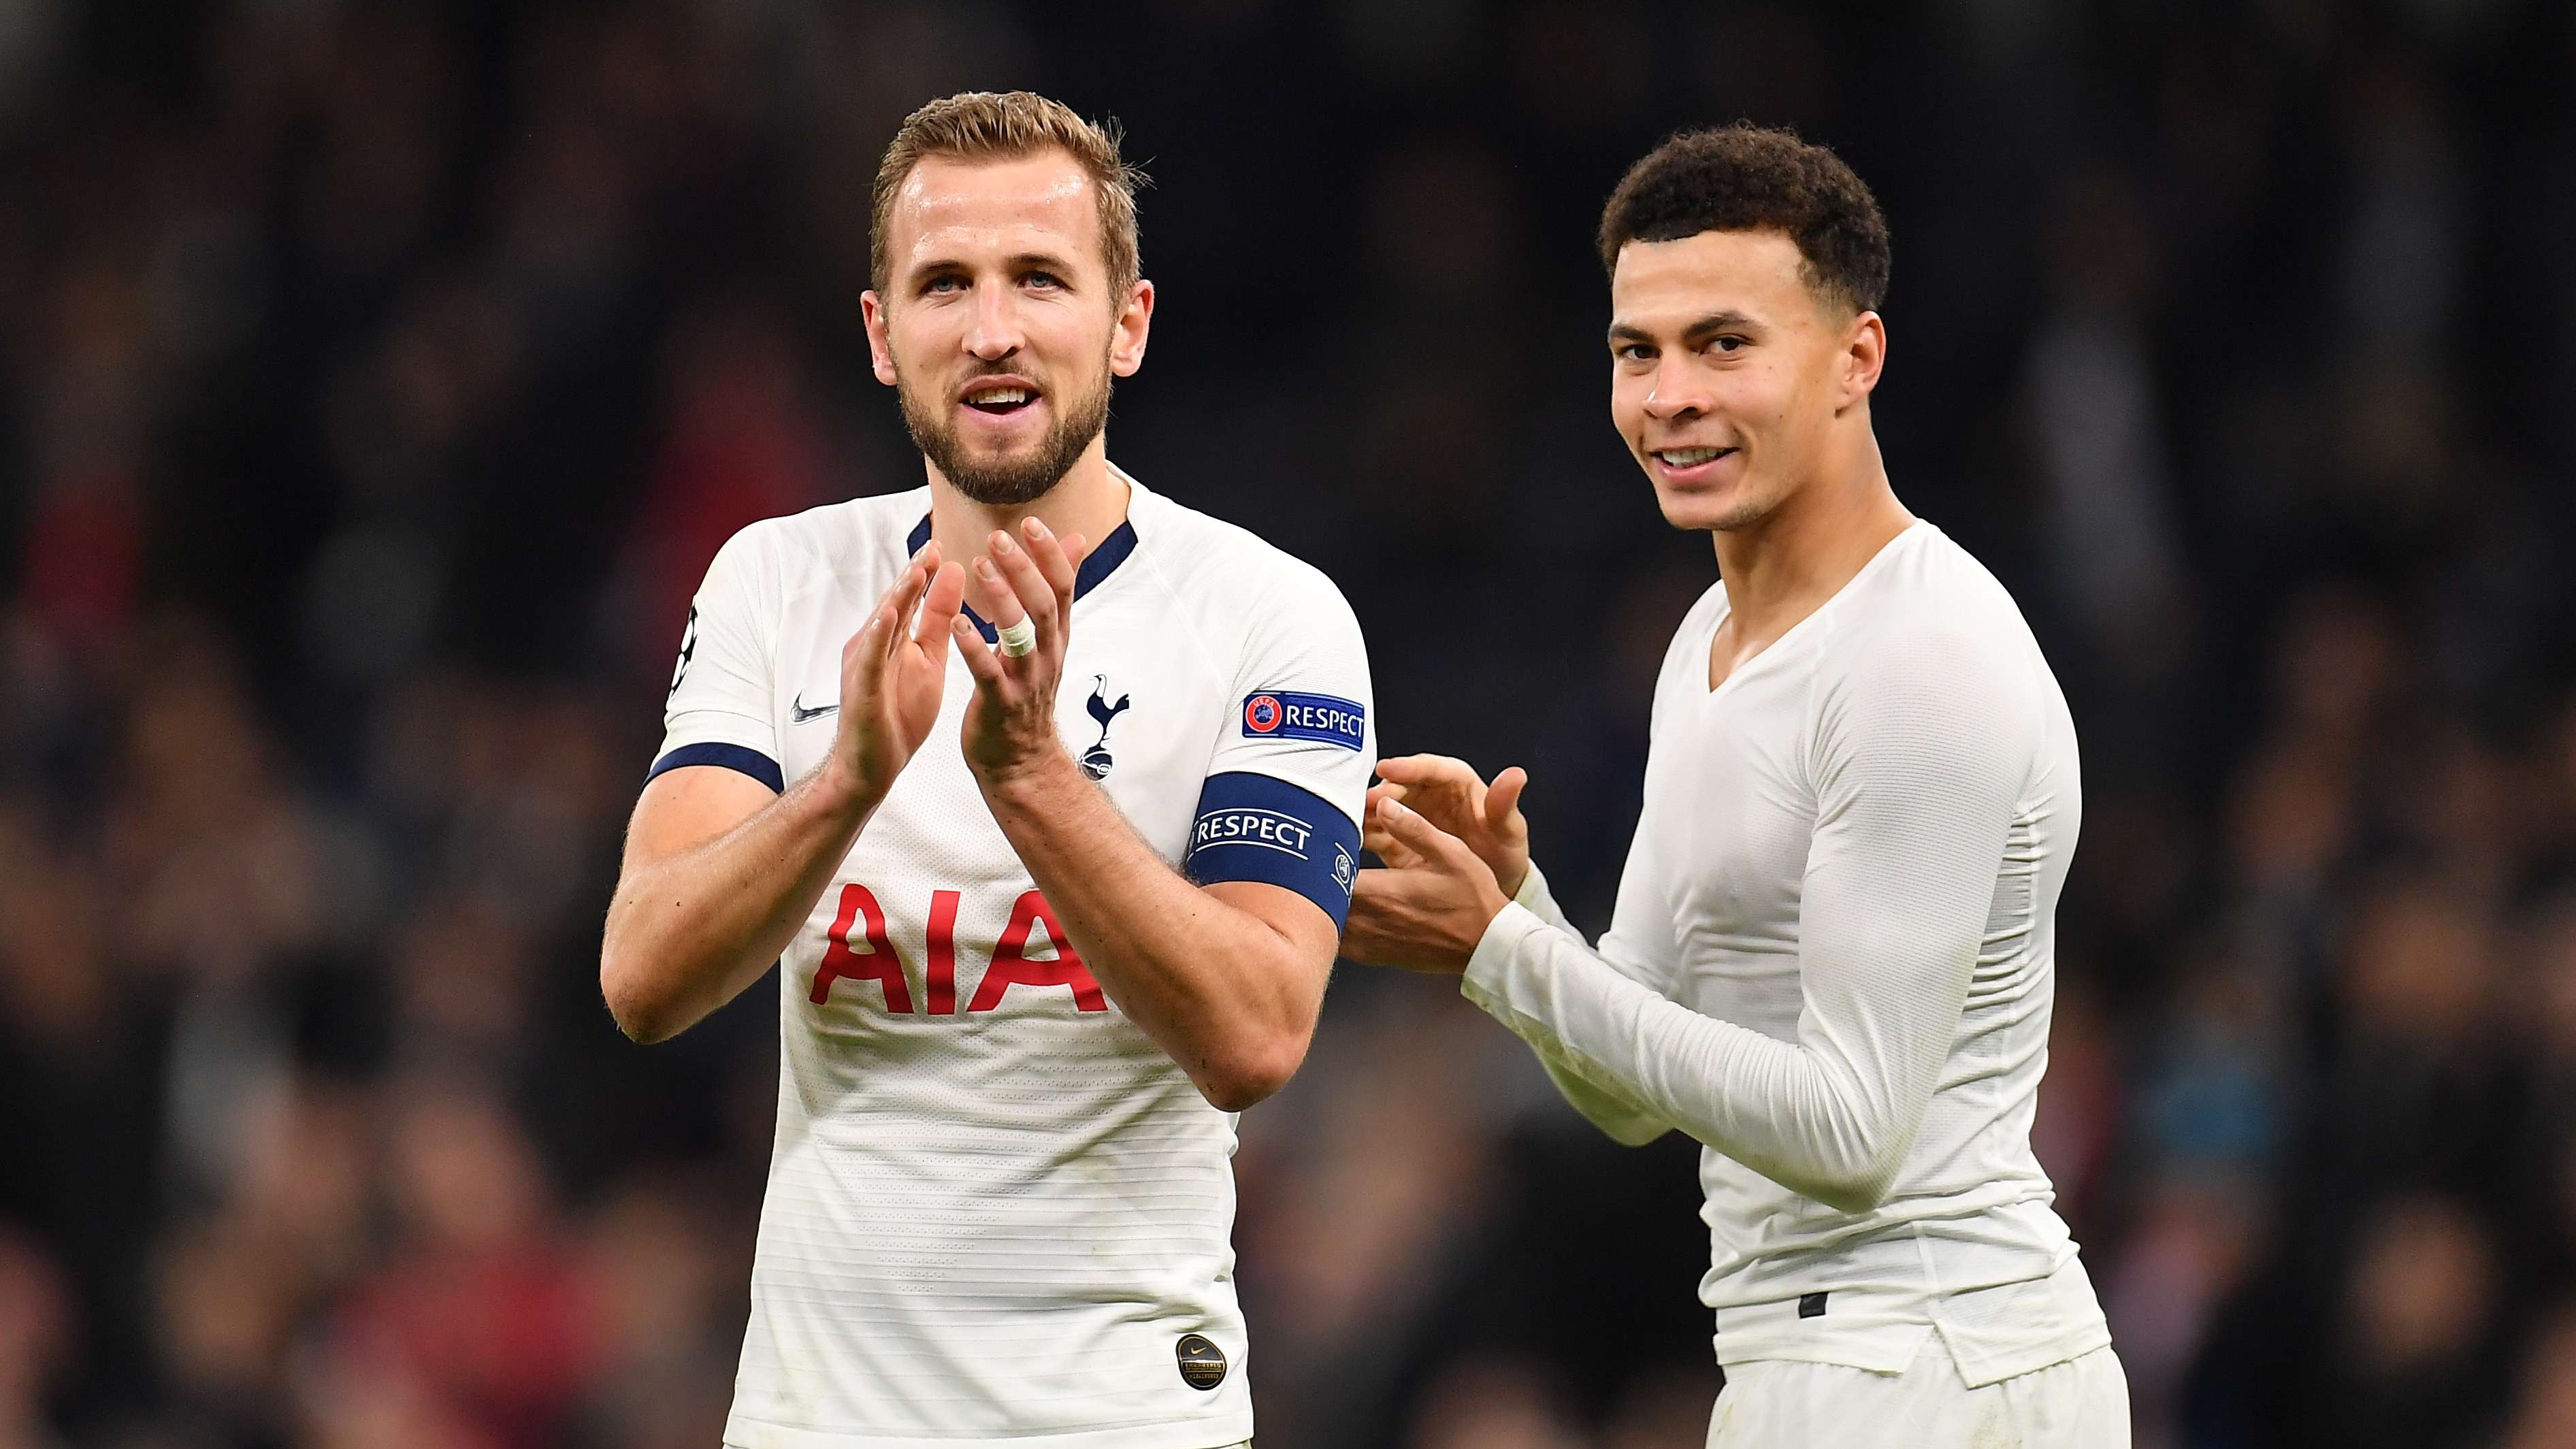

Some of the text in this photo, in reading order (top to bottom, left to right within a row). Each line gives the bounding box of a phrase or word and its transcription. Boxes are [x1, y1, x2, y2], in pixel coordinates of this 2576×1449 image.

[1253, 698, 1275, 707] UEFA
[1286, 705, 1364, 738] RESPECT
[1196, 815, 1311, 850] RESPECT
[809, 883, 1109, 1015] AIA
